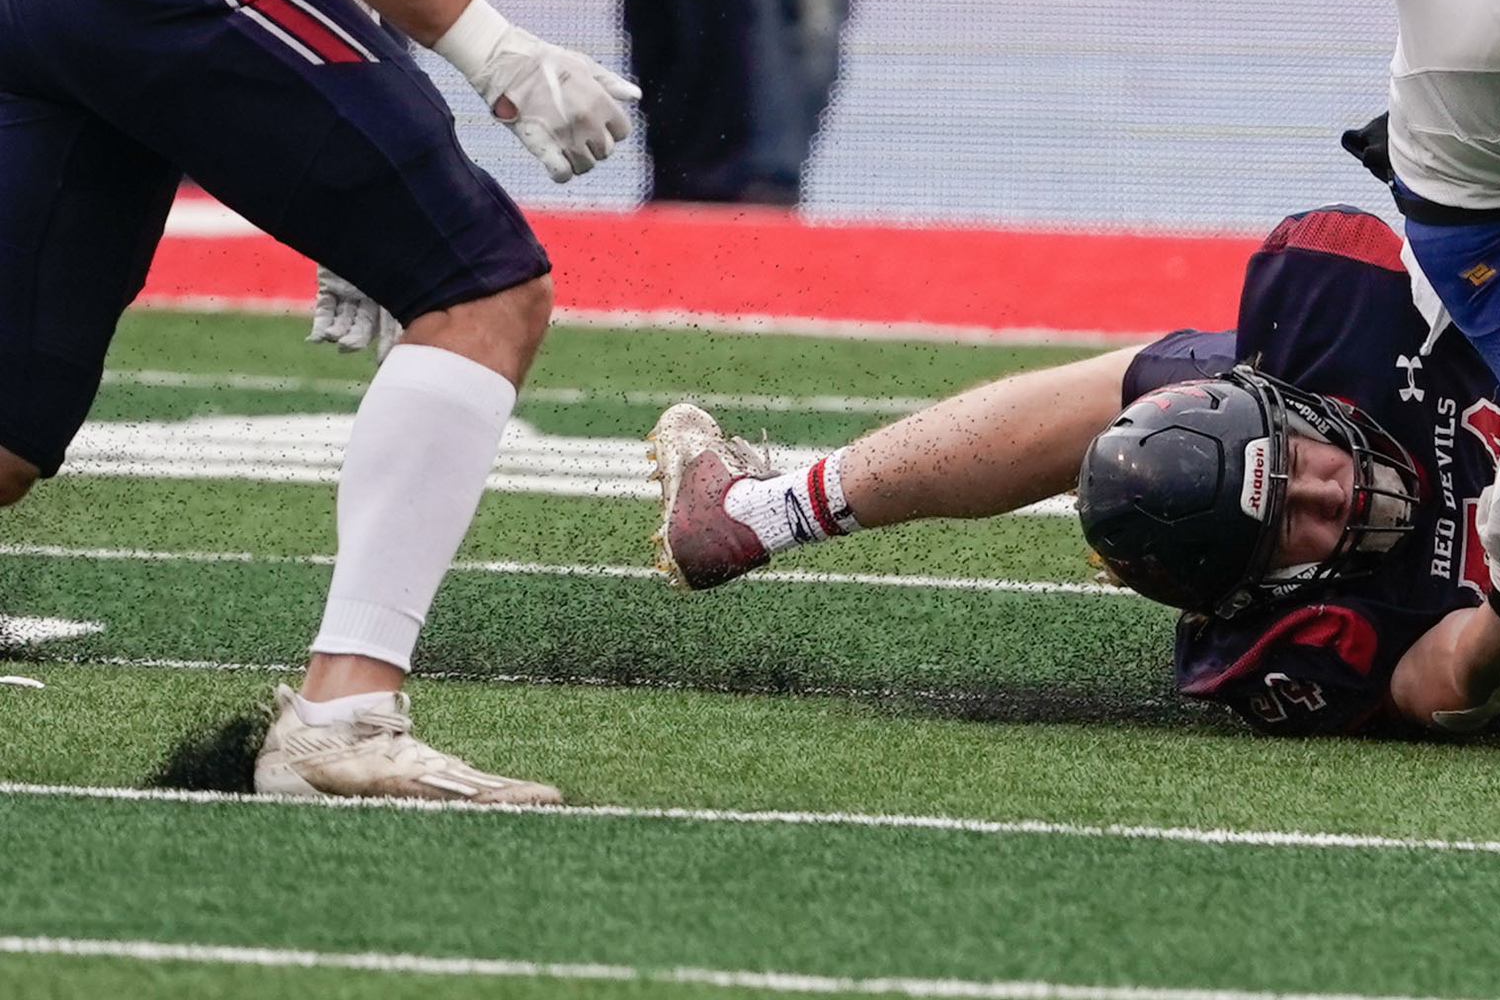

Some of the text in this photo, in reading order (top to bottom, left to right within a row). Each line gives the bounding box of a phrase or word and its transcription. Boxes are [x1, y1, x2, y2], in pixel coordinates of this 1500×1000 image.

[1285, 398, 1332, 435] Ridde
[1430, 396, 1458, 580] RED DEVILS
